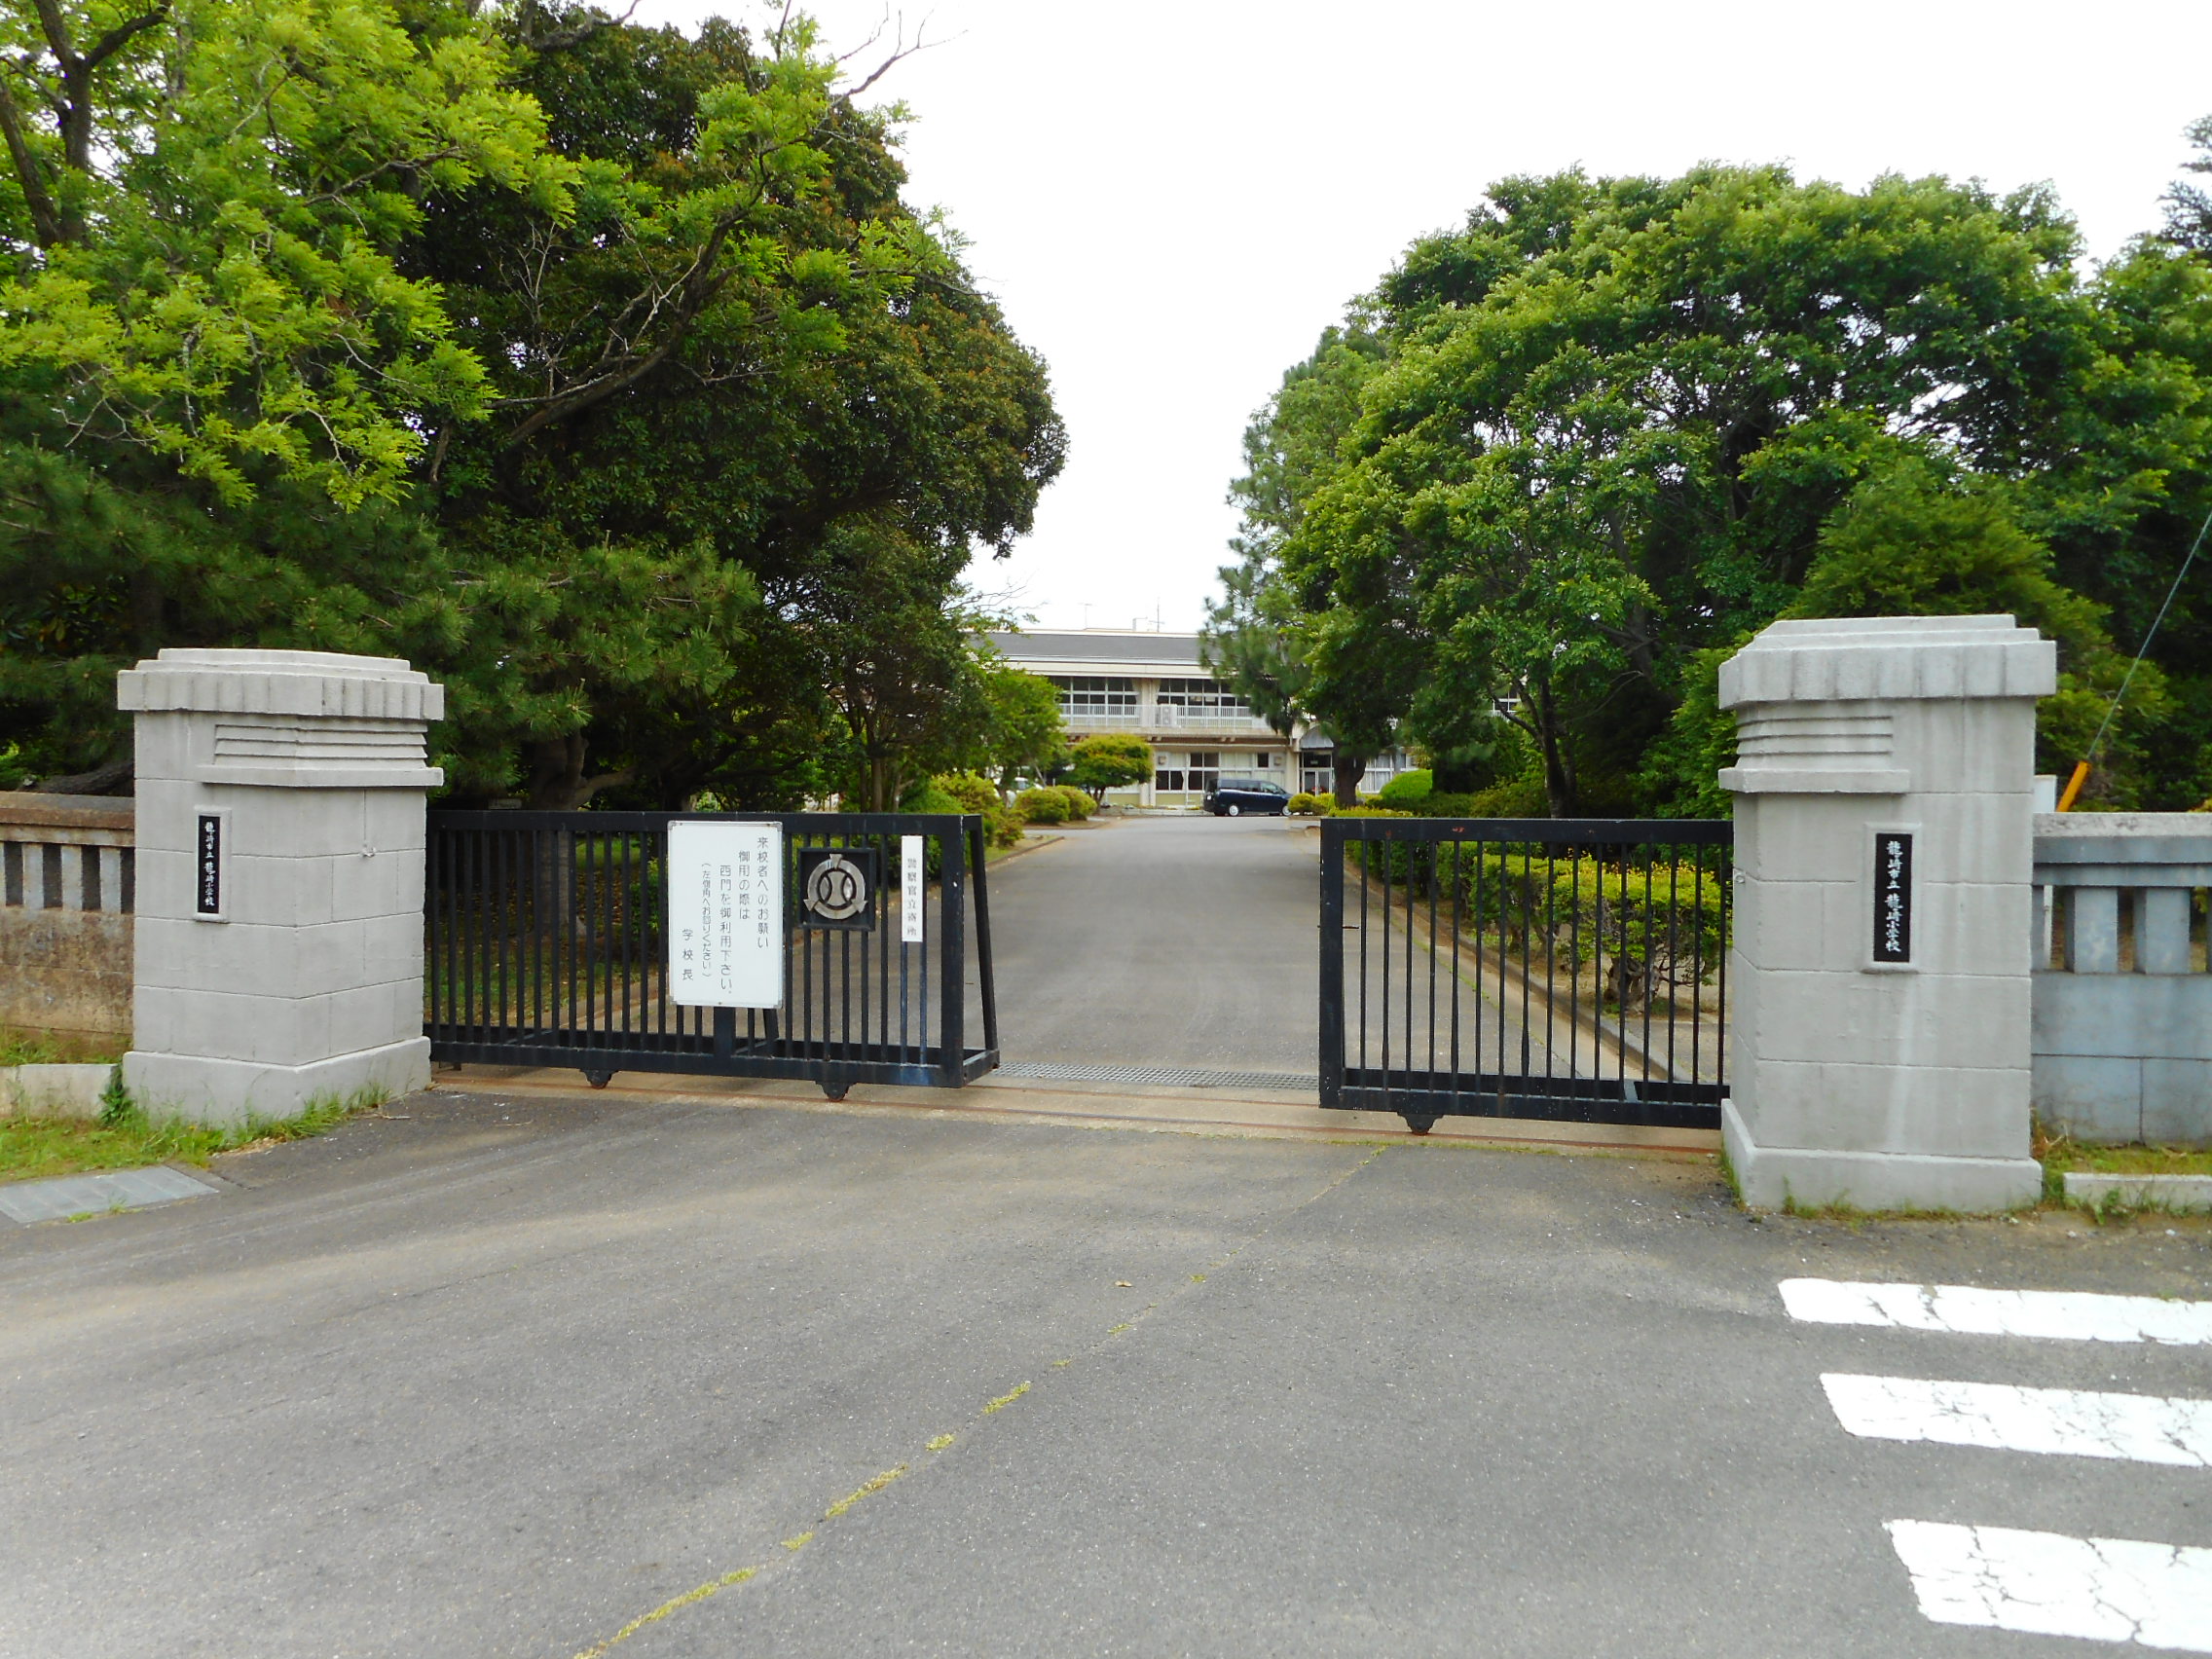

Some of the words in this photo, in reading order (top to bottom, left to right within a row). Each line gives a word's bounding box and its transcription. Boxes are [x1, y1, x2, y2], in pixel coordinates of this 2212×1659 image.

[738, 850, 751, 920] 御用の際は
[756, 836, 769, 949] 来校者へのお願い
[682, 928, 693, 981] 学校長
